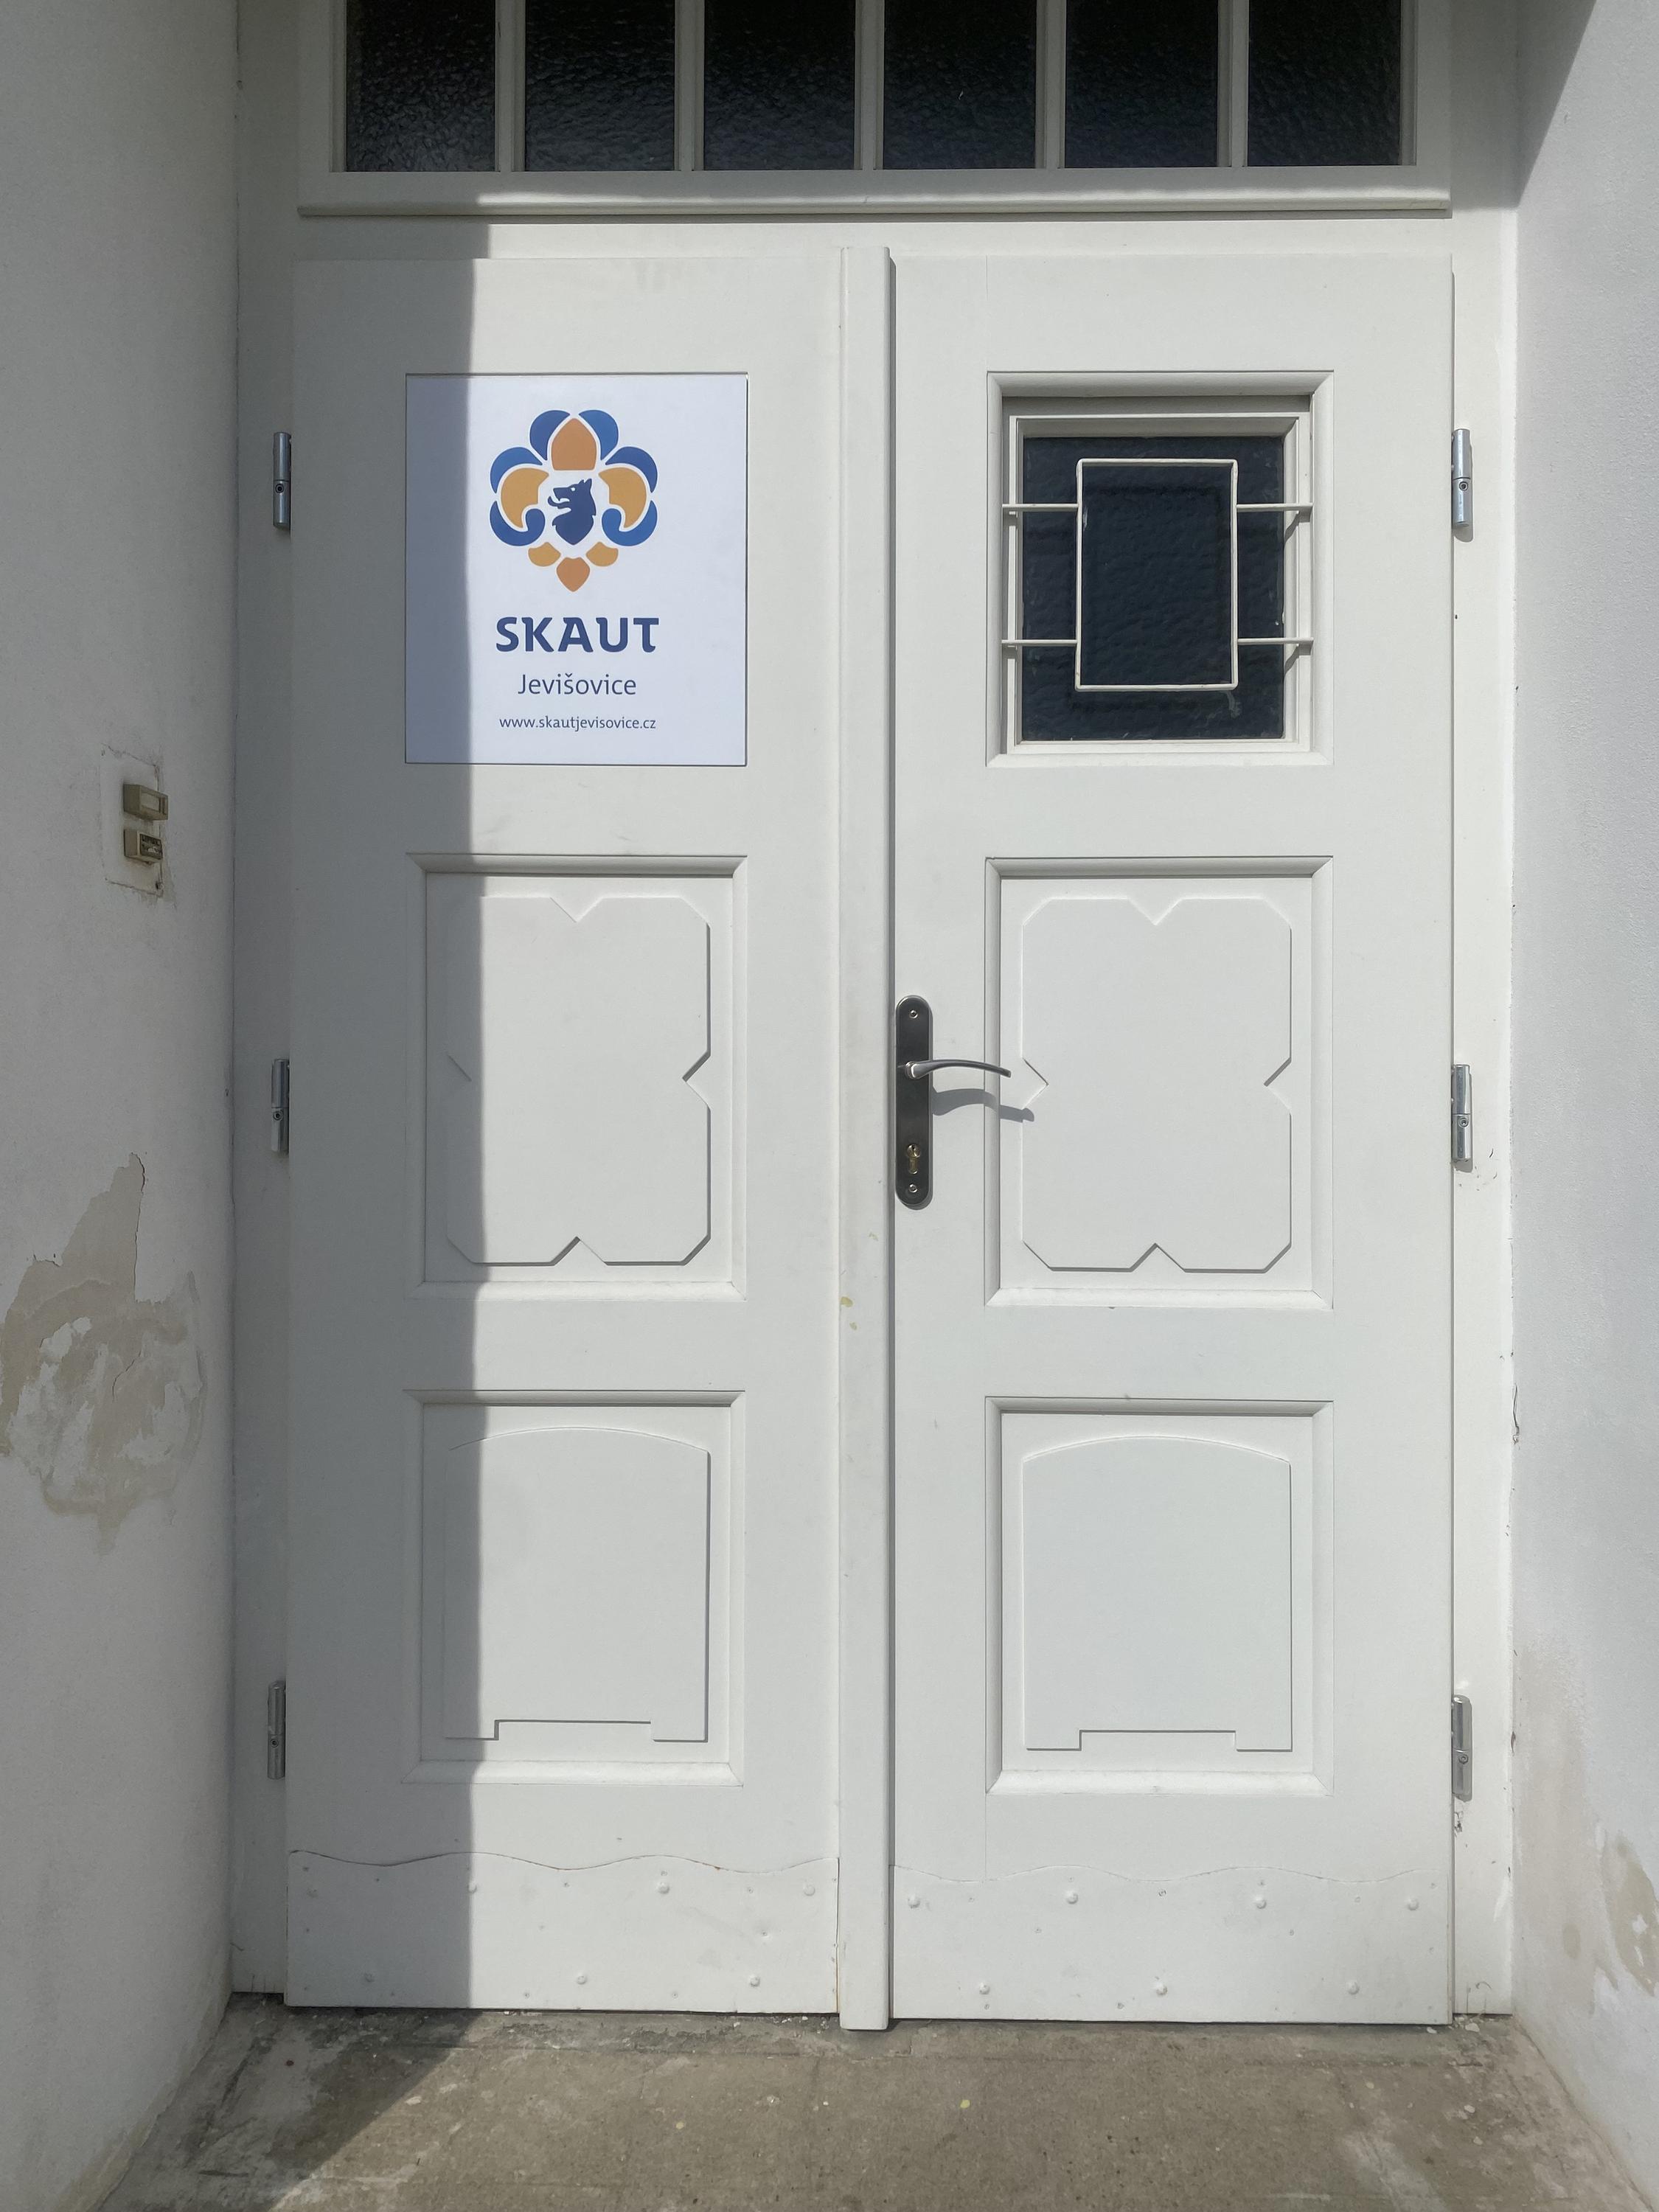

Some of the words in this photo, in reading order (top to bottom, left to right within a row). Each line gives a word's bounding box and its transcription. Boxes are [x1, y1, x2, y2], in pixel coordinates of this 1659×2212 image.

[496, 617, 659, 653] SKAUT
[518, 672, 636, 695] Jevišovice
[499, 715, 655, 731] www.skautjevisovice.cz
